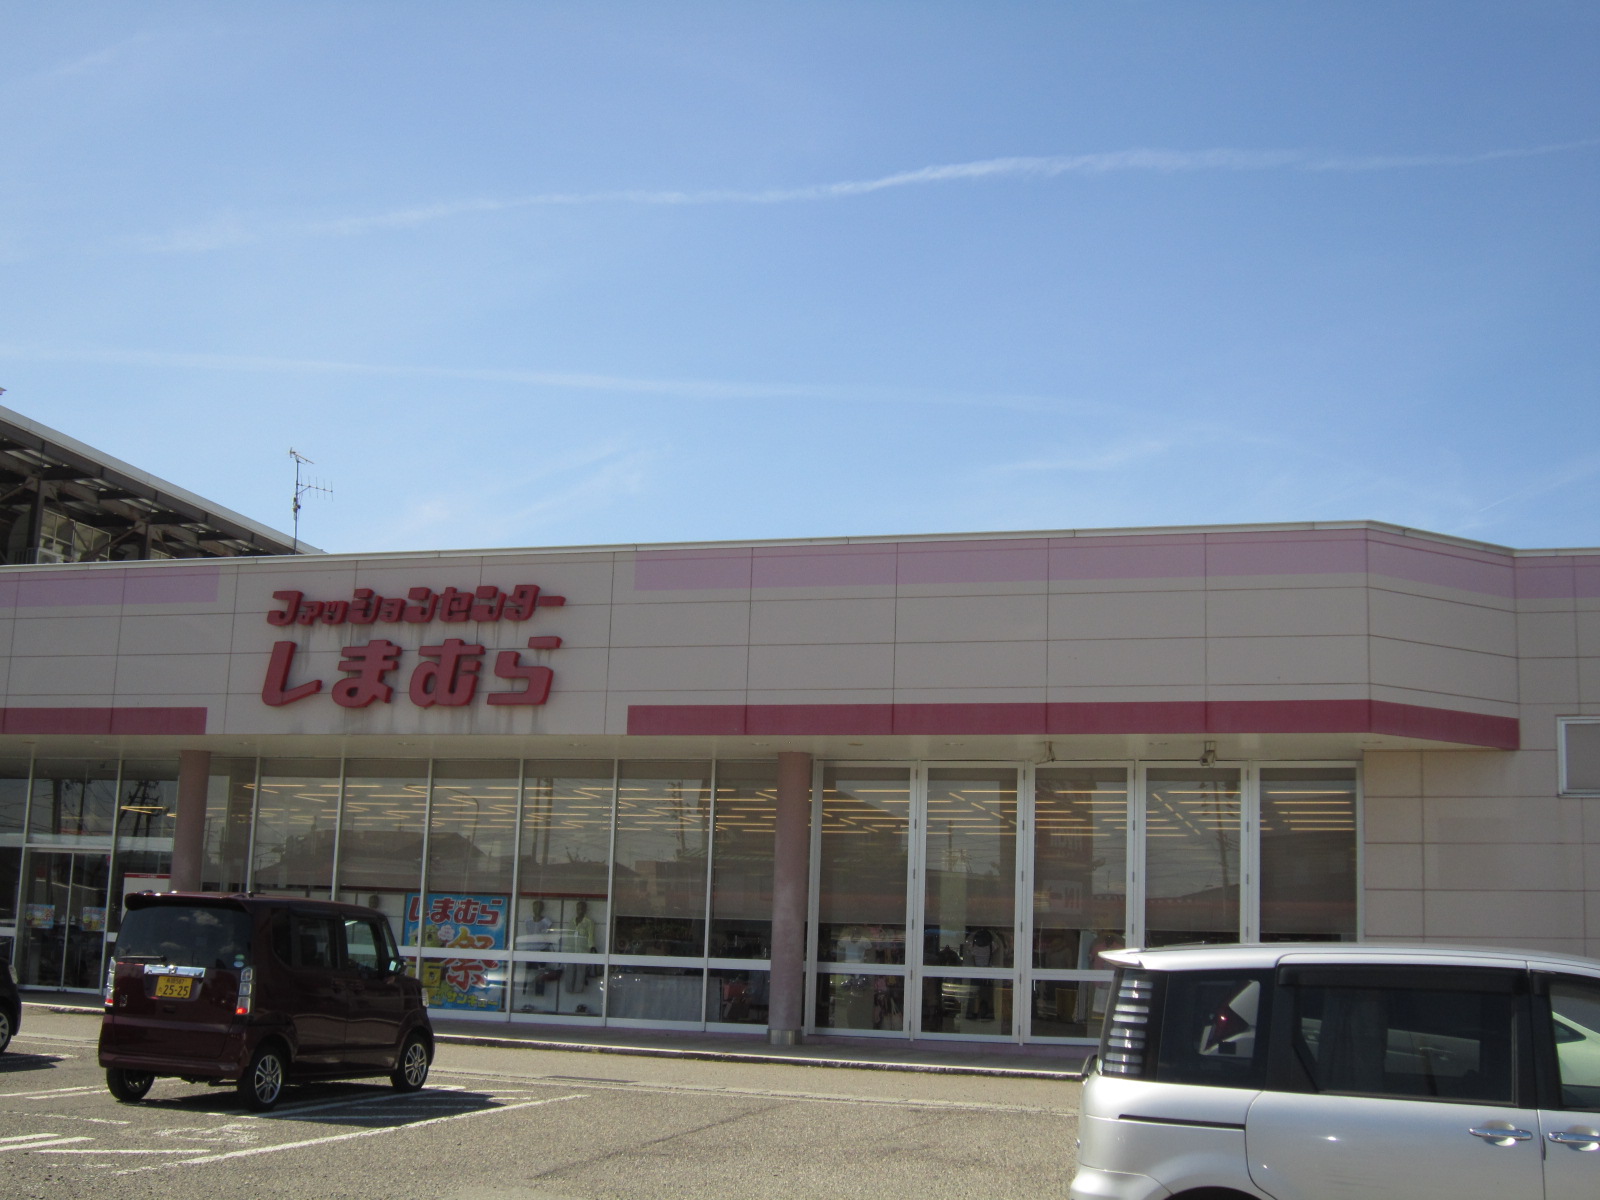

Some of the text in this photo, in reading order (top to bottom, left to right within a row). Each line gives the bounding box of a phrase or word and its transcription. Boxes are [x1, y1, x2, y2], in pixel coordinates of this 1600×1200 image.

[267, 584, 566, 626] ファッションセンター
[262, 636, 562, 708] しまむら
[408, 896, 503, 925] しまむら
[163, 984, 189, 997] 25-25
